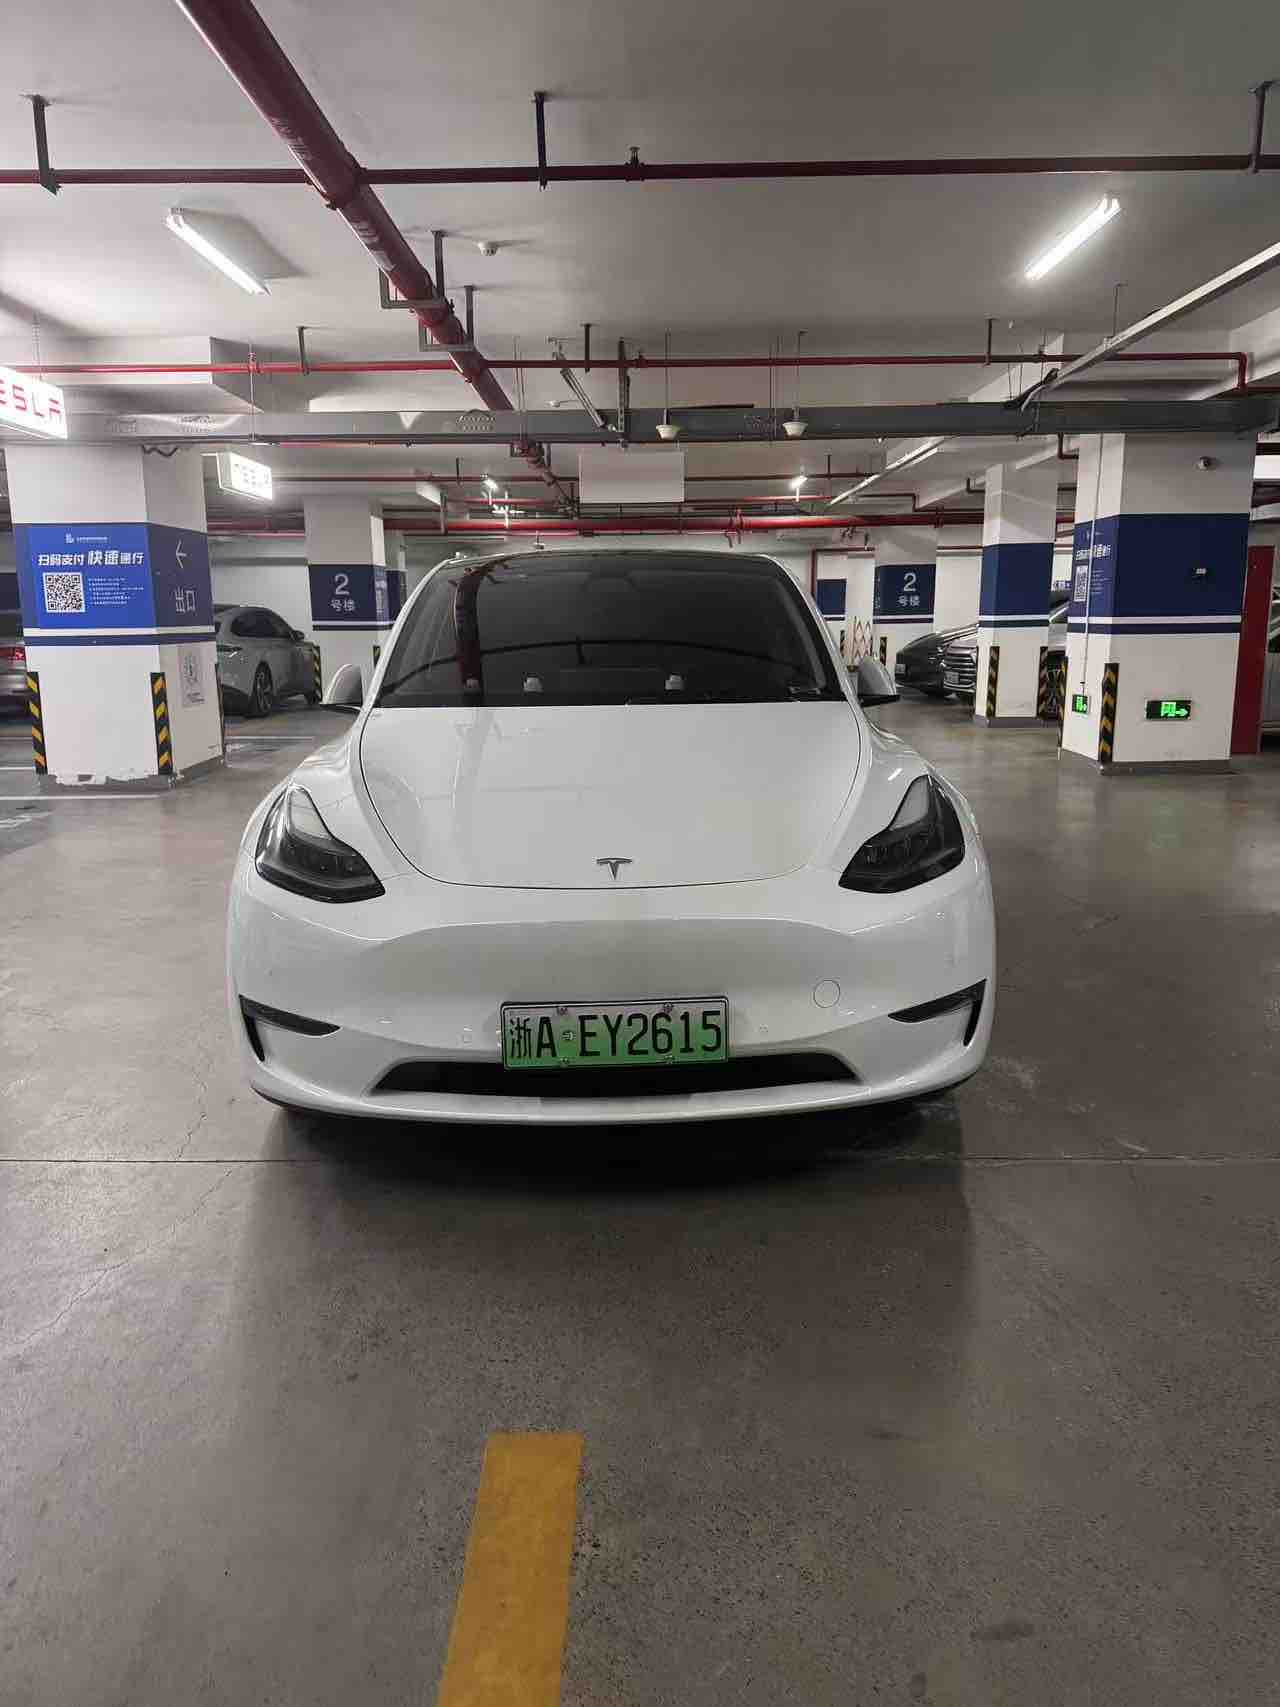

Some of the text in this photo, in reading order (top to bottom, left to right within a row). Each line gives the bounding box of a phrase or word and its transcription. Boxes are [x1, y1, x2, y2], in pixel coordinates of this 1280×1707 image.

[334, 573, 350, 596] 2
[903, 572, 917, 592] 2
[175, 586, 196, 613] 出口
[577, 1010, 722, 1057] EY2615
